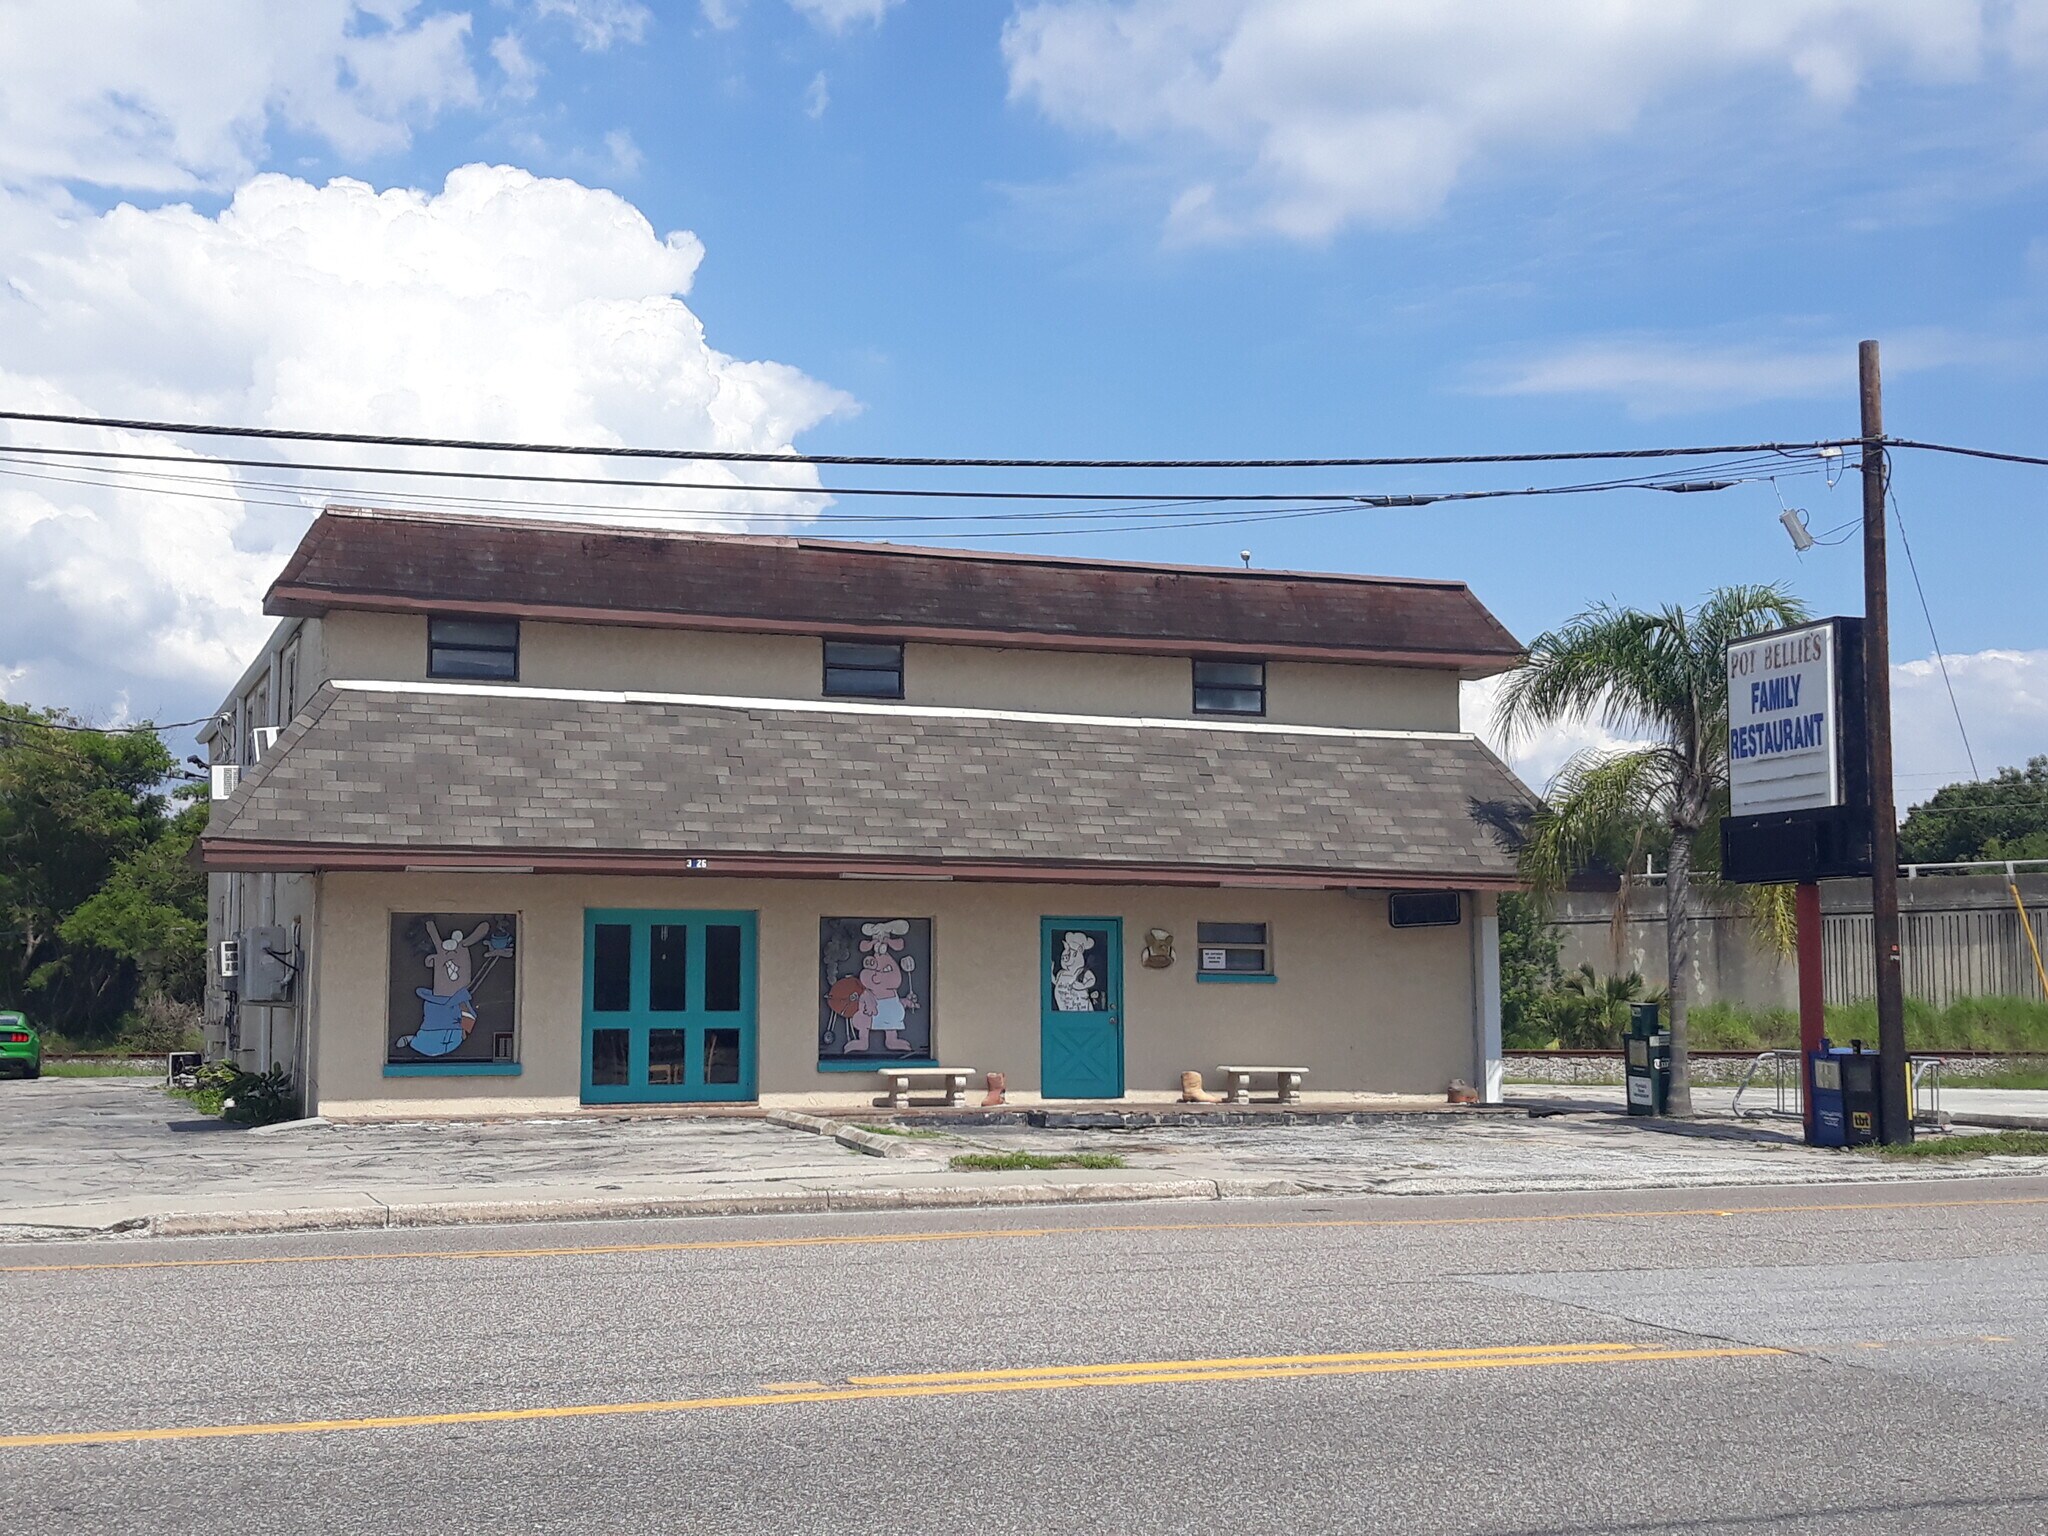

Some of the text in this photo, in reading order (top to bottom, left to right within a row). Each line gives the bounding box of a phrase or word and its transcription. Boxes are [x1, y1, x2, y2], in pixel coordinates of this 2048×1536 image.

[1730, 633, 1822, 679] POT BELLIE'S
[1750, 673, 1801, 715] FAMILY
[1730, 712, 1824, 760] RESTAURANT
